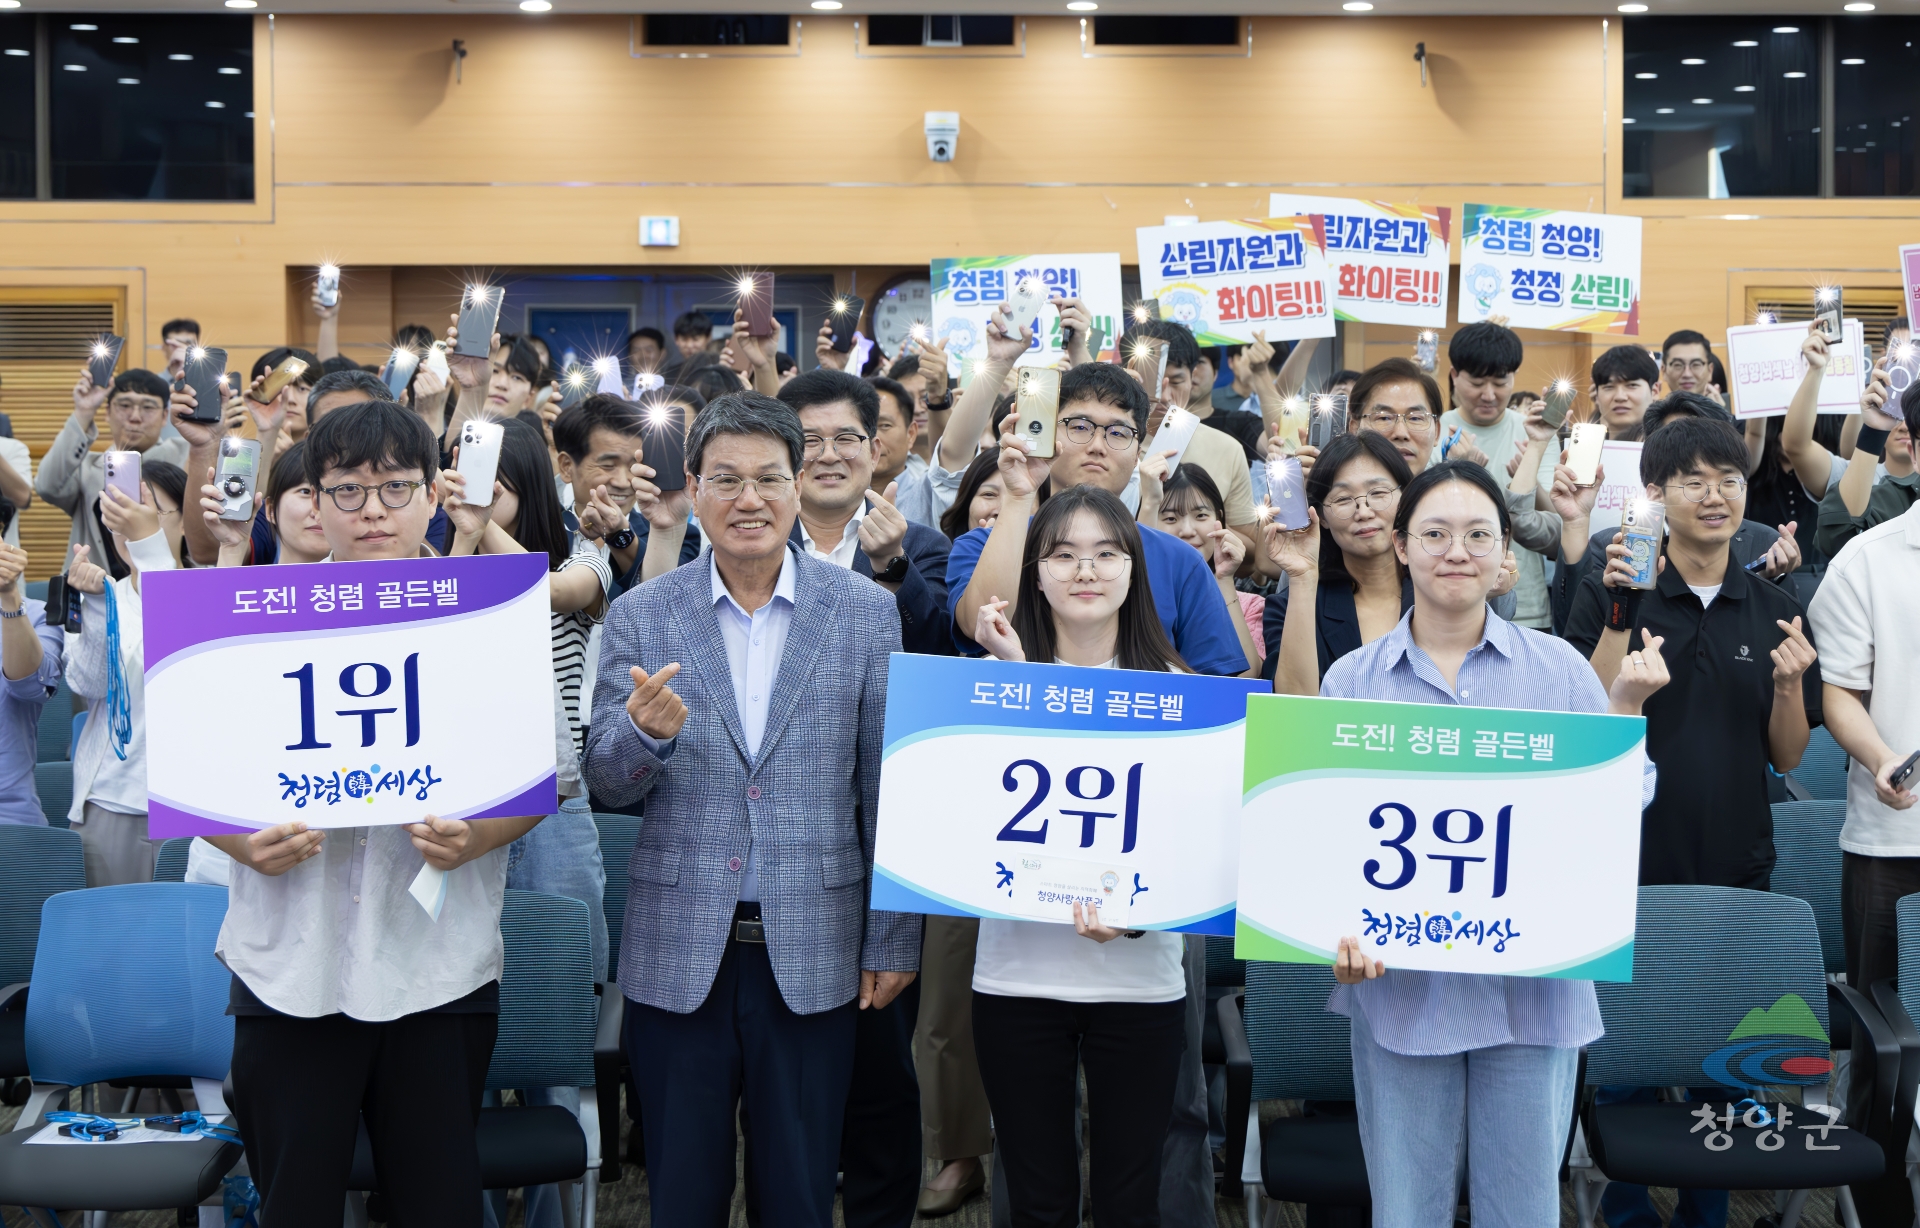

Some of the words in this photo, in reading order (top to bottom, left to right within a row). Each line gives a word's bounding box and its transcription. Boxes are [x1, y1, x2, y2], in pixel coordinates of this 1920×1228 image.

[1296, 212, 1429, 254] 림자원과
[1481, 218, 1532, 252] 청렴
[1541, 223, 1600, 258] 청양!
[1160, 232, 1304, 278] 산림자원과
[952, 269, 1005, 302] 청렴
[1216, 280, 1324, 322] 화이팅!!
[1338, 263, 1440, 305] 화이팅!!
[1510, 268, 1561, 303] 청정
[1570, 273, 1630, 308] 산림!
[232, 586, 298, 615] 도전!
[309, 582, 364, 613] 청렴
[375, 577, 459, 609] 골든벨
[282, 652, 421, 751] 1위
[969, 681, 1032, 711] 도전!
[1042, 685, 1094, 716] 청렴
[1104, 690, 1184, 722] 골든벨
[1331, 722, 1396, 753] 도전!
[1407, 725, 1461, 756] 청렴
[1472, 729, 1555, 762] 골든벨
[996, 758, 1144, 854] 2위
[1363, 802, 1514, 899] 3위
